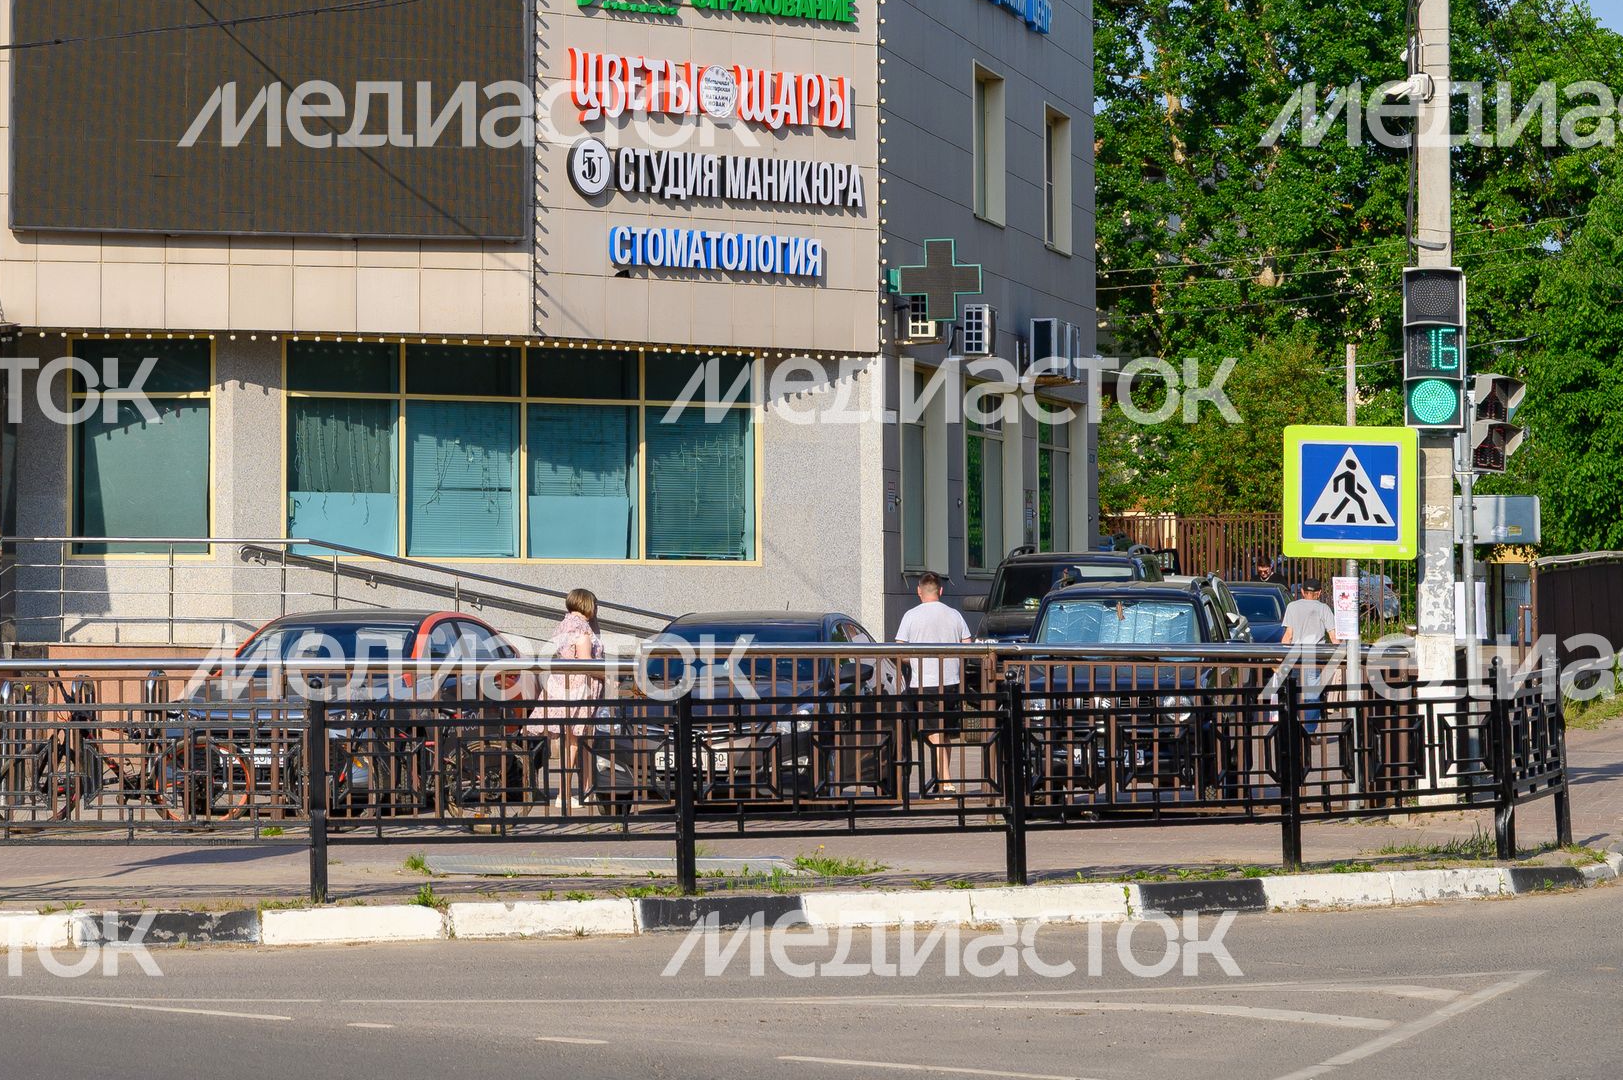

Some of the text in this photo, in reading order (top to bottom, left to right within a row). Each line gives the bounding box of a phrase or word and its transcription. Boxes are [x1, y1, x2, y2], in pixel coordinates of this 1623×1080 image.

[568, 48, 852, 130] ЦВЕТЫ ШАРЫ
[618, 147, 863, 207] СТУДИЯ МАНИКЮРА
[610, 226, 822, 277] СТОМАТОЛОГИЯ
[1431, 328, 1458, 370] 16
